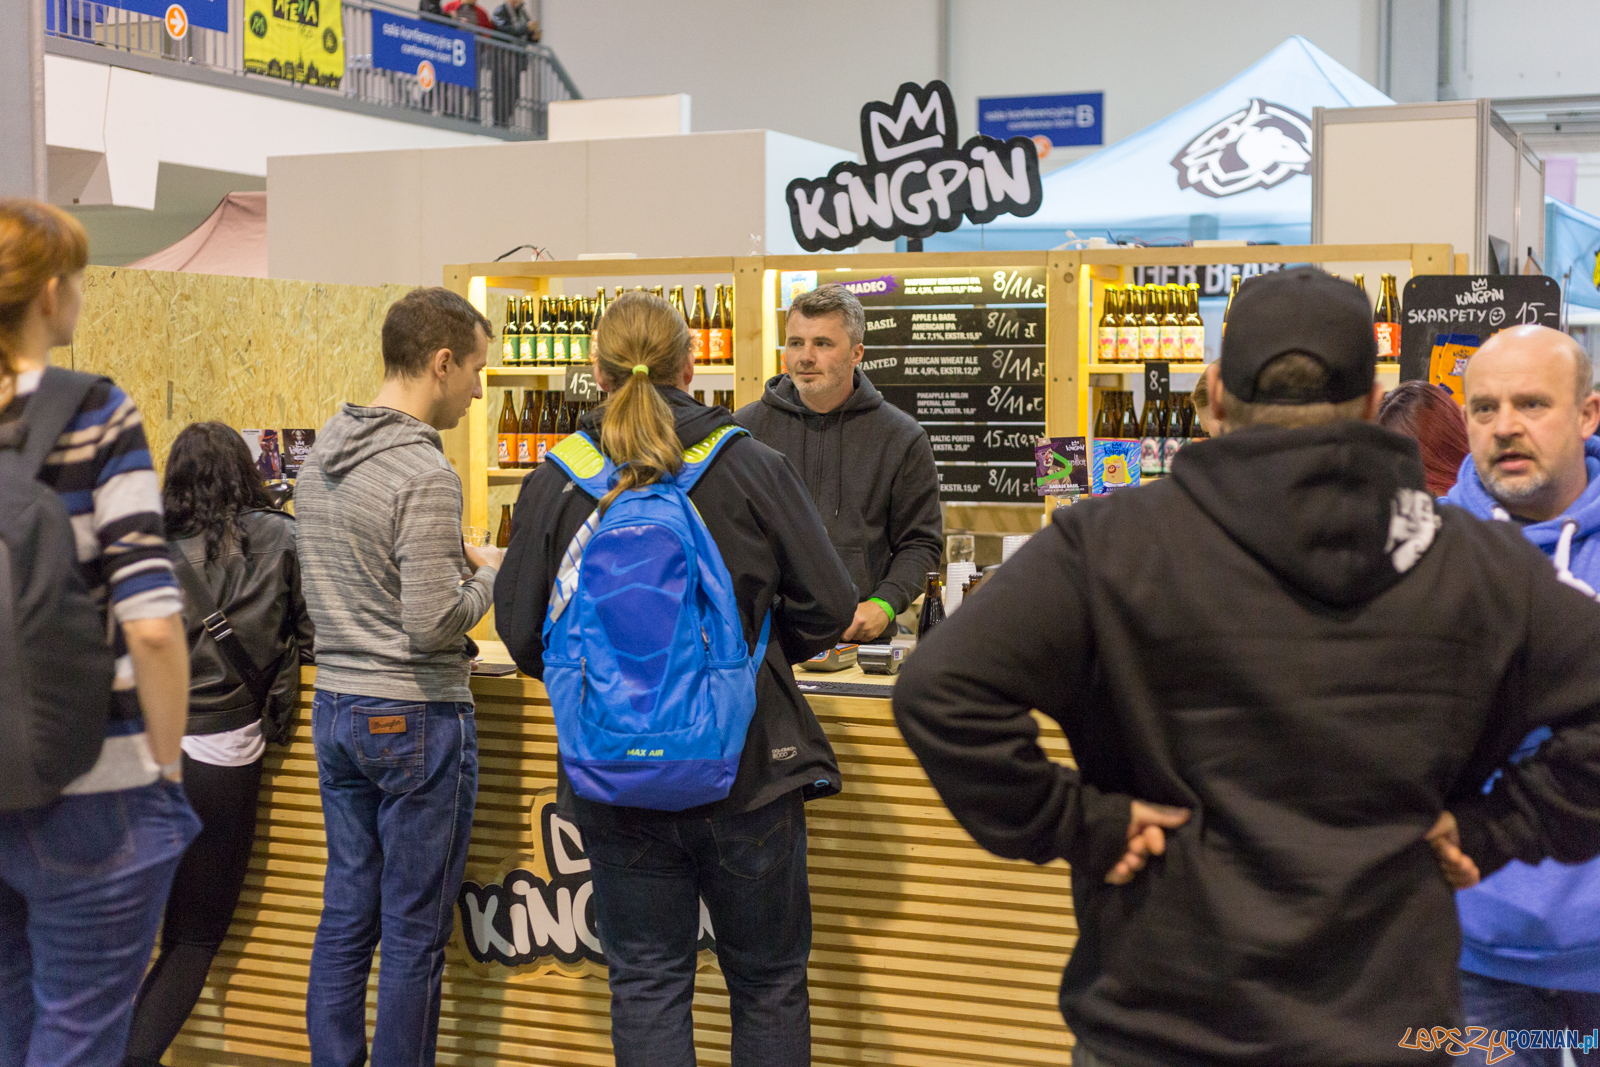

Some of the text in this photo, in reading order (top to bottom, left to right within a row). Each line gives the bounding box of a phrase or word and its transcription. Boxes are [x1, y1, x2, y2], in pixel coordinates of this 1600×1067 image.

[452, 38, 466, 67] B
[1075, 104, 1095, 128] B
[845, 281, 887, 294] MADEO
[993, 270, 1032, 299] 8/11
[911, 313, 957, 321] APPLE & BASIL
[1407, 308, 1487, 324] SKARPETY
[866, 317, 897, 331] BASIL
[912, 322, 956, 331] AMERICAN IPA
[987, 311, 1019, 339] 8/11
[912, 332, 927, 340] ALK.
[904, 356, 978, 365] AMERICAN WHEAT ALE
[992, 349, 1031, 381] 8/11
[904, 367, 920, 375] ALK.
[987, 385, 1023, 415] 8/11
[930, 435, 975, 443] BALTIC PORTER
[983, 430, 1004, 448] 15
[988, 468, 1020, 497] 8/11
[626, 748, 664, 757] MAX AIR
